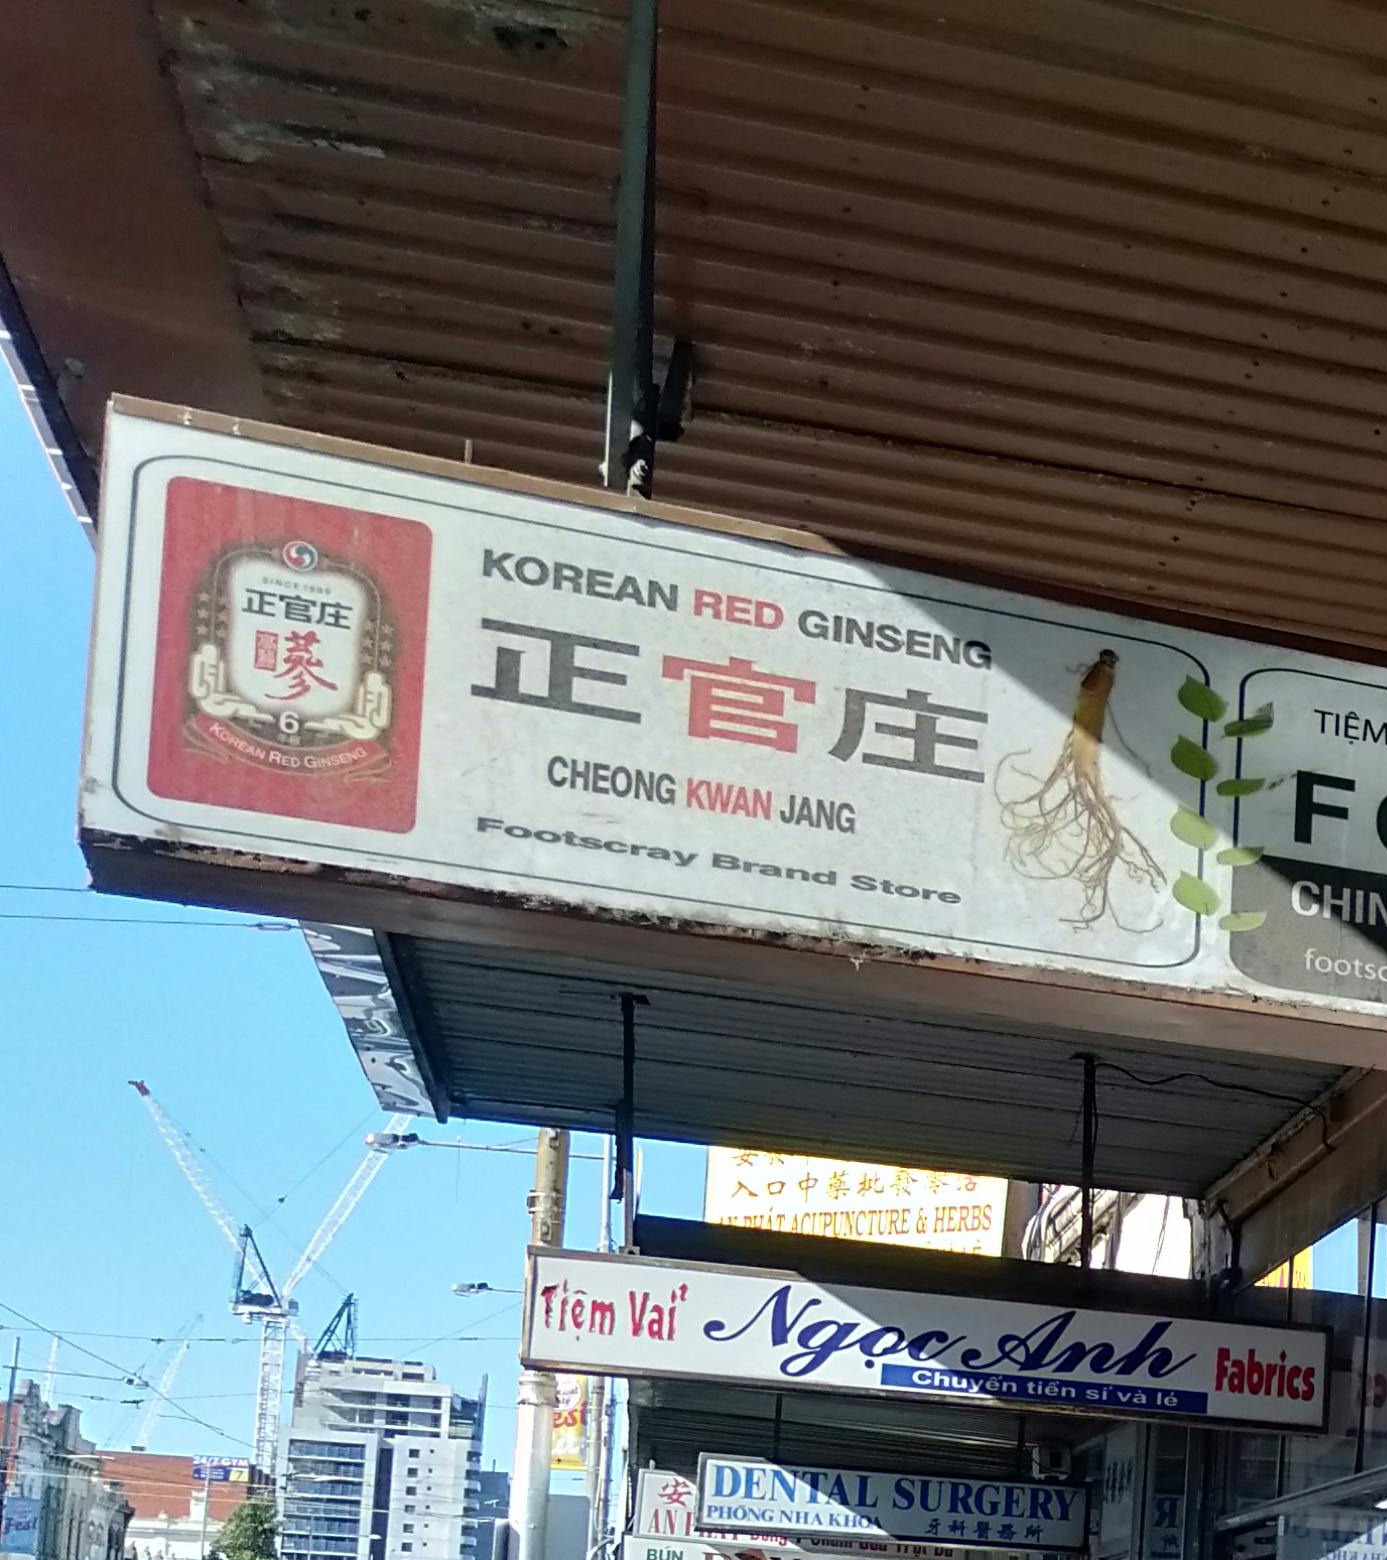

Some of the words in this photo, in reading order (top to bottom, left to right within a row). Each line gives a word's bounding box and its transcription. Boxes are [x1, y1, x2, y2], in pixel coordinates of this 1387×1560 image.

[242, 588, 354, 629] 正官庄
[483, 548, 678, 612] KOREAN
[693, 588, 784, 629] RED
[798, 610, 992, 670] GINSENG
[279, 711, 300, 734] 6
[470, 617, 989, 783] 正官庄
[547, 755, 677, 805] CHEONG
[686, 778, 772, 820] KWAN
[780, 796, 856, 834] JANG
[476, 816, 698, 866] Footscray
[712, 853, 837, 887] Brand
[850, 874, 962, 905] Store
[933, 1204, 992, 1233] HERBS
[961, 1310, 1197, 1378] Anh
[1215, 1347, 1316, 1401] Fabrics
[712, 1463, 880, 1508] DENTAL
[891, 1478, 1077, 1521] SURGERY
[780, 1510, 823, 1525] NHA
[829, 1513, 881, 1529] KHOA
[648, 1510, 687, 1535] AN
